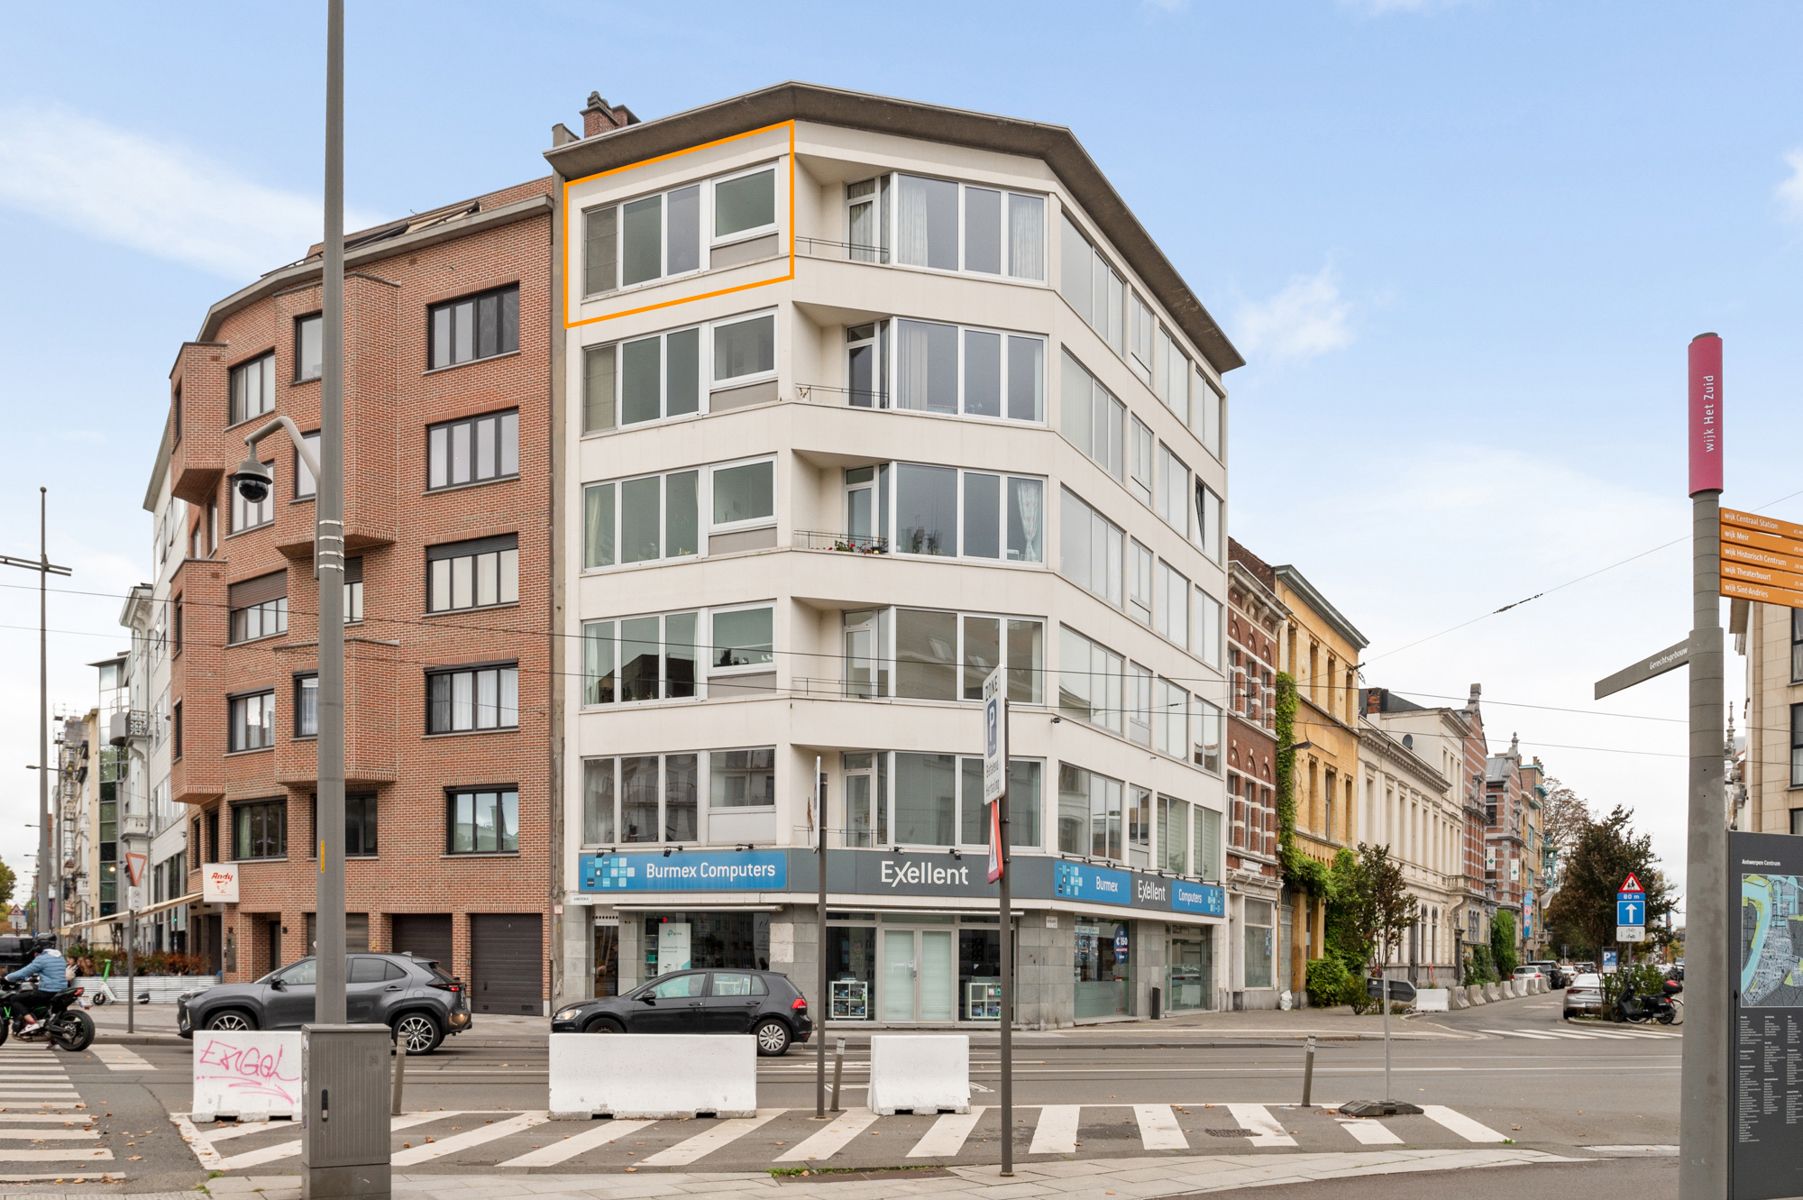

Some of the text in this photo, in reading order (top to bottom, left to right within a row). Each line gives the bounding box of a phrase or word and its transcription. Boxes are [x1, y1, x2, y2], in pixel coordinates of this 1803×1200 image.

[1703, 375, 1716, 453] wijk Het Zuid
[1736, 515, 1759, 526] Centraal
[1760, 519, 1779, 530] Station
[1764, 555, 1787, 567] Centrum
[985, 675, 998, 702] ZONE
[646, 862, 776, 882] Burmex Computers
[880, 860, 969, 888] Exellent
[1096, 876, 1119, 893] Burmex
[1137, 879, 1166, 903] Exellent
[1178, 888, 1203, 907] Computers
